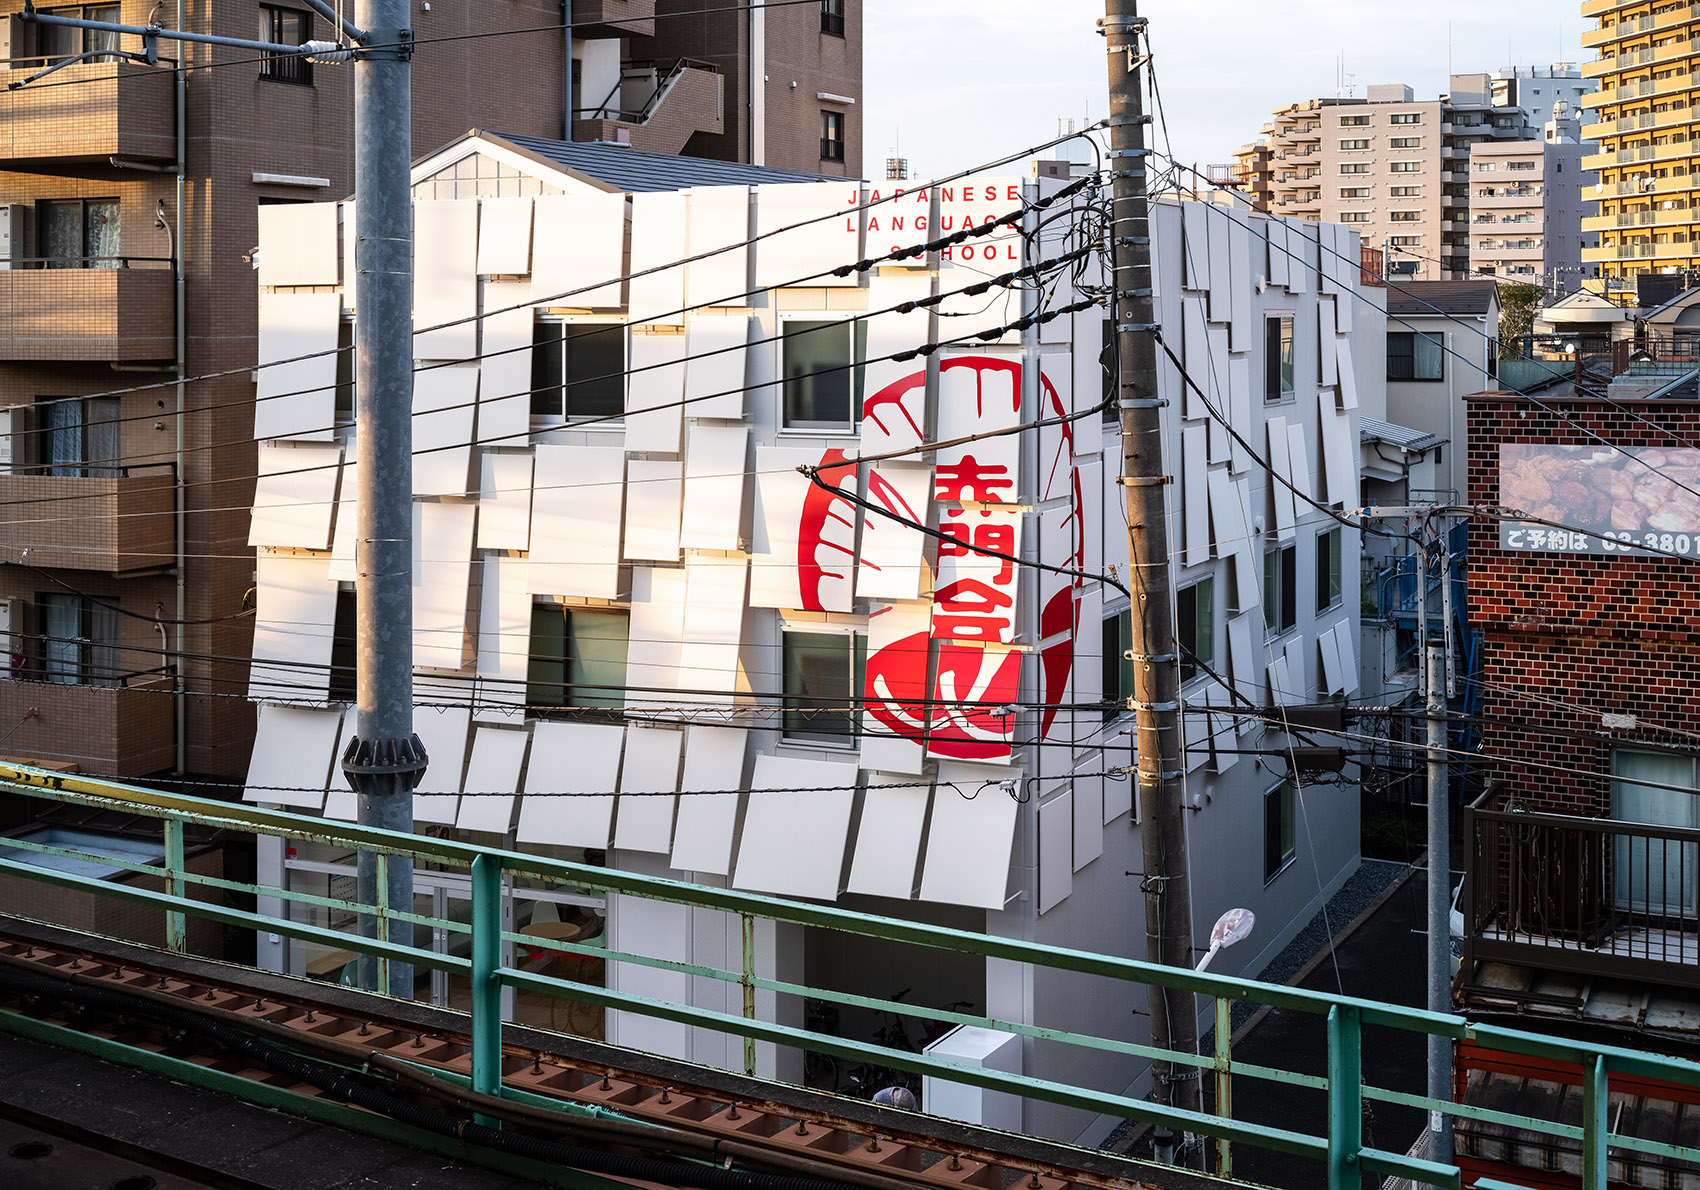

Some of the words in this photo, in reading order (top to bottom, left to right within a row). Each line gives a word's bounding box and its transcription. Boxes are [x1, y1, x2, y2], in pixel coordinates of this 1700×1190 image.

[848, 185, 1018, 204] JAPANESE
[890, 245, 1018, 261] HOOL
[1507, 529, 1589, 551] ご予約は
